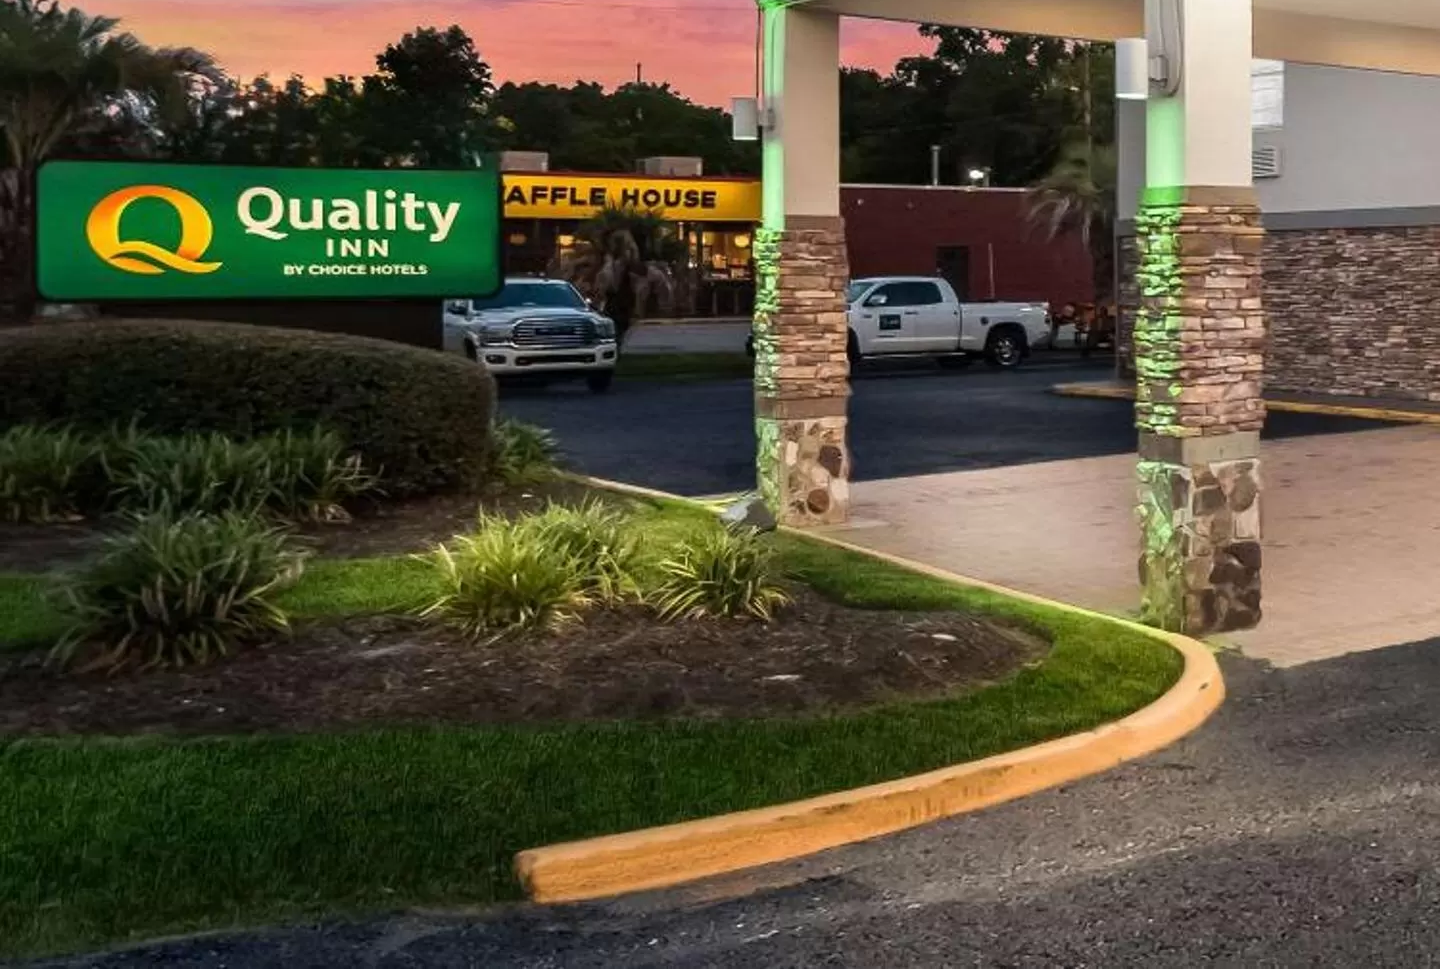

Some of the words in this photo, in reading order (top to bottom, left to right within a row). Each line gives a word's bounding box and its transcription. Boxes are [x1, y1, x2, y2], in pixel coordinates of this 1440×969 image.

[502, 184, 607, 207] AFFLE
[621, 187, 717, 209] HOUSE
[237, 186, 462, 243] Quality
[326, 237, 389, 258] INN
[283, 264, 304, 276] BY
[308, 264, 368, 276] CHOICE
[370, 263, 429, 276] HOTELS
